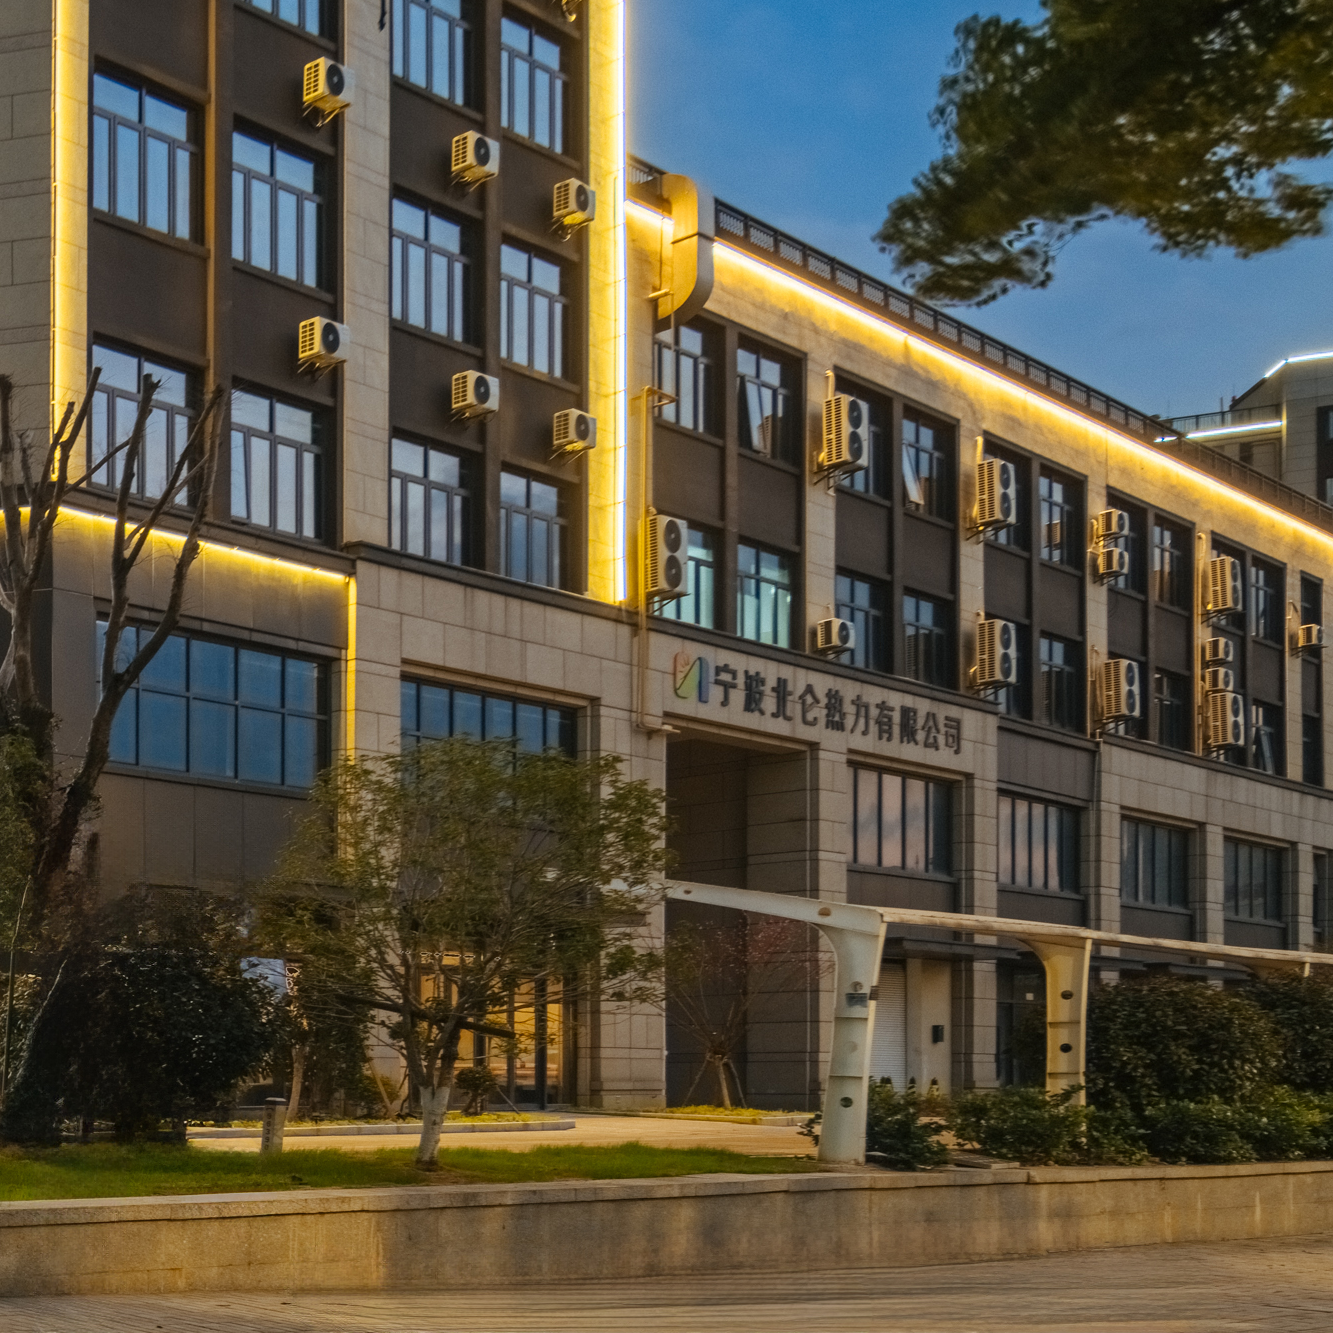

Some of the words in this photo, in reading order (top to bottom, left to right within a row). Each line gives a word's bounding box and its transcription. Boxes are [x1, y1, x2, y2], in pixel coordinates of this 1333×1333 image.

[714, 663, 962, 754] 宁波北仑热力有限公司
